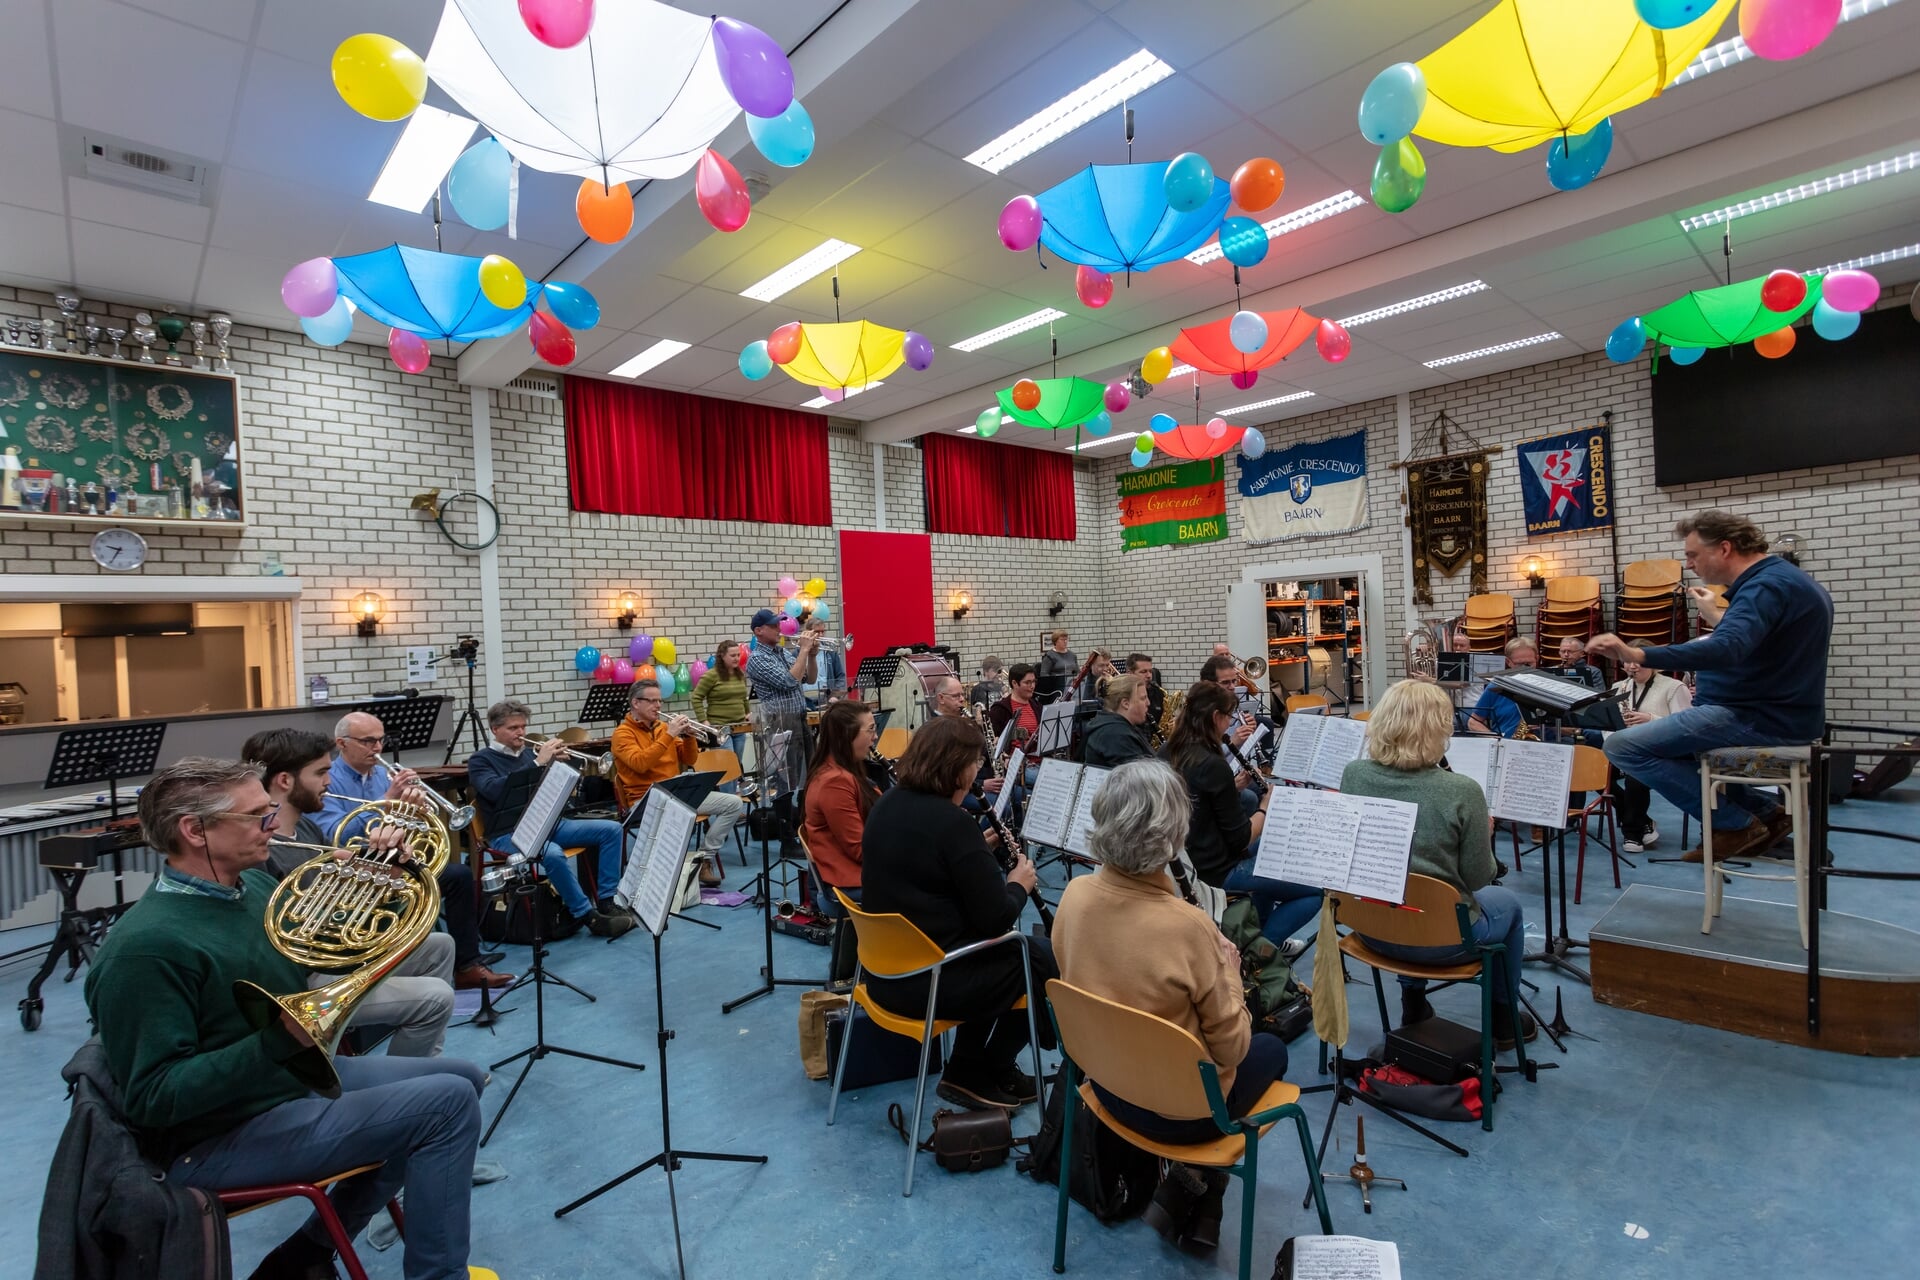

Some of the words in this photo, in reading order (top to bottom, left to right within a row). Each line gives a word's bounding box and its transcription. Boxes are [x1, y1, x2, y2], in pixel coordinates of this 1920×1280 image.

[1123, 469, 1177, 492] HARMONIE
[1249, 461, 1295, 494] HARMONIE
[1589, 435, 1608, 518] CRESCENDO
[1147, 494, 1203, 512] Crescendo
[1284, 507, 1325, 523] BAARN
[1434, 514, 1462, 525] BAARN
[1179, 520, 1219, 539] BAARN
[1528, 519, 1561, 532] BAARN
